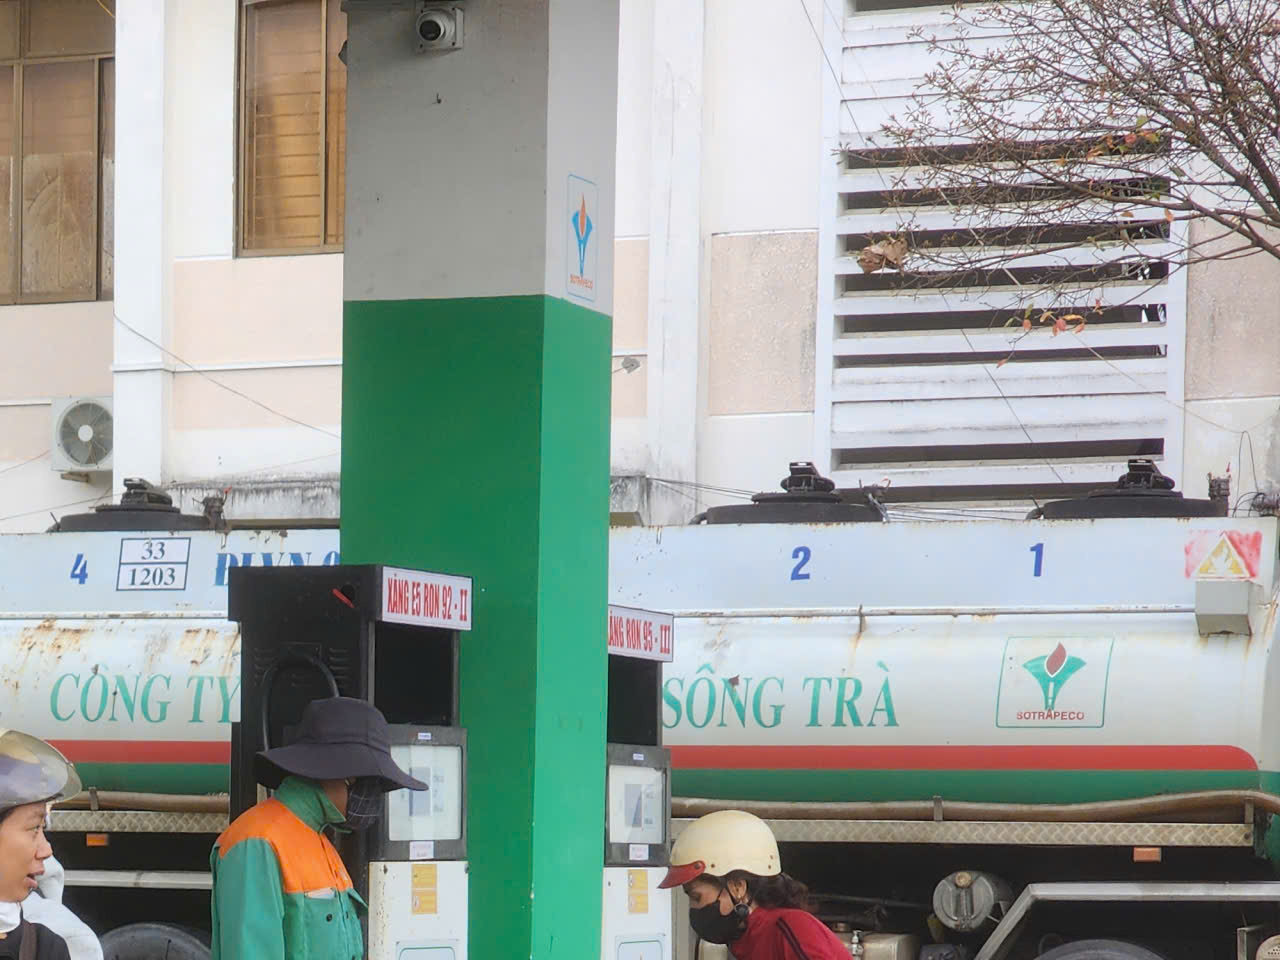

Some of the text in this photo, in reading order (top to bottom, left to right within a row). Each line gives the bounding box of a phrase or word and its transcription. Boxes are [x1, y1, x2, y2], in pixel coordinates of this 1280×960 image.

[141, 541, 166, 561] 33
[790, 546, 812, 581] 2
[1029, 542, 1045, 577] 1
[70, 553, 88, 585] 4
[129, 567, 175, 587] 1203
[387, 573, 409, 615] XĂNG
[412, 581, 421, 616] E5
[424, 583, 440, 618] RON
[442, 584, 452, 620] 92
[608, 609, 624, 648] ĂNG
[626, 617, 641, 650] RON
[643, 621, 653, 652] 95
[50, 663, 241, 724] CÔNG TY
[662, 660, 900, 729] SÔNG TRÀ
[1016, 706, 1085, 720] SOTRAPECO
